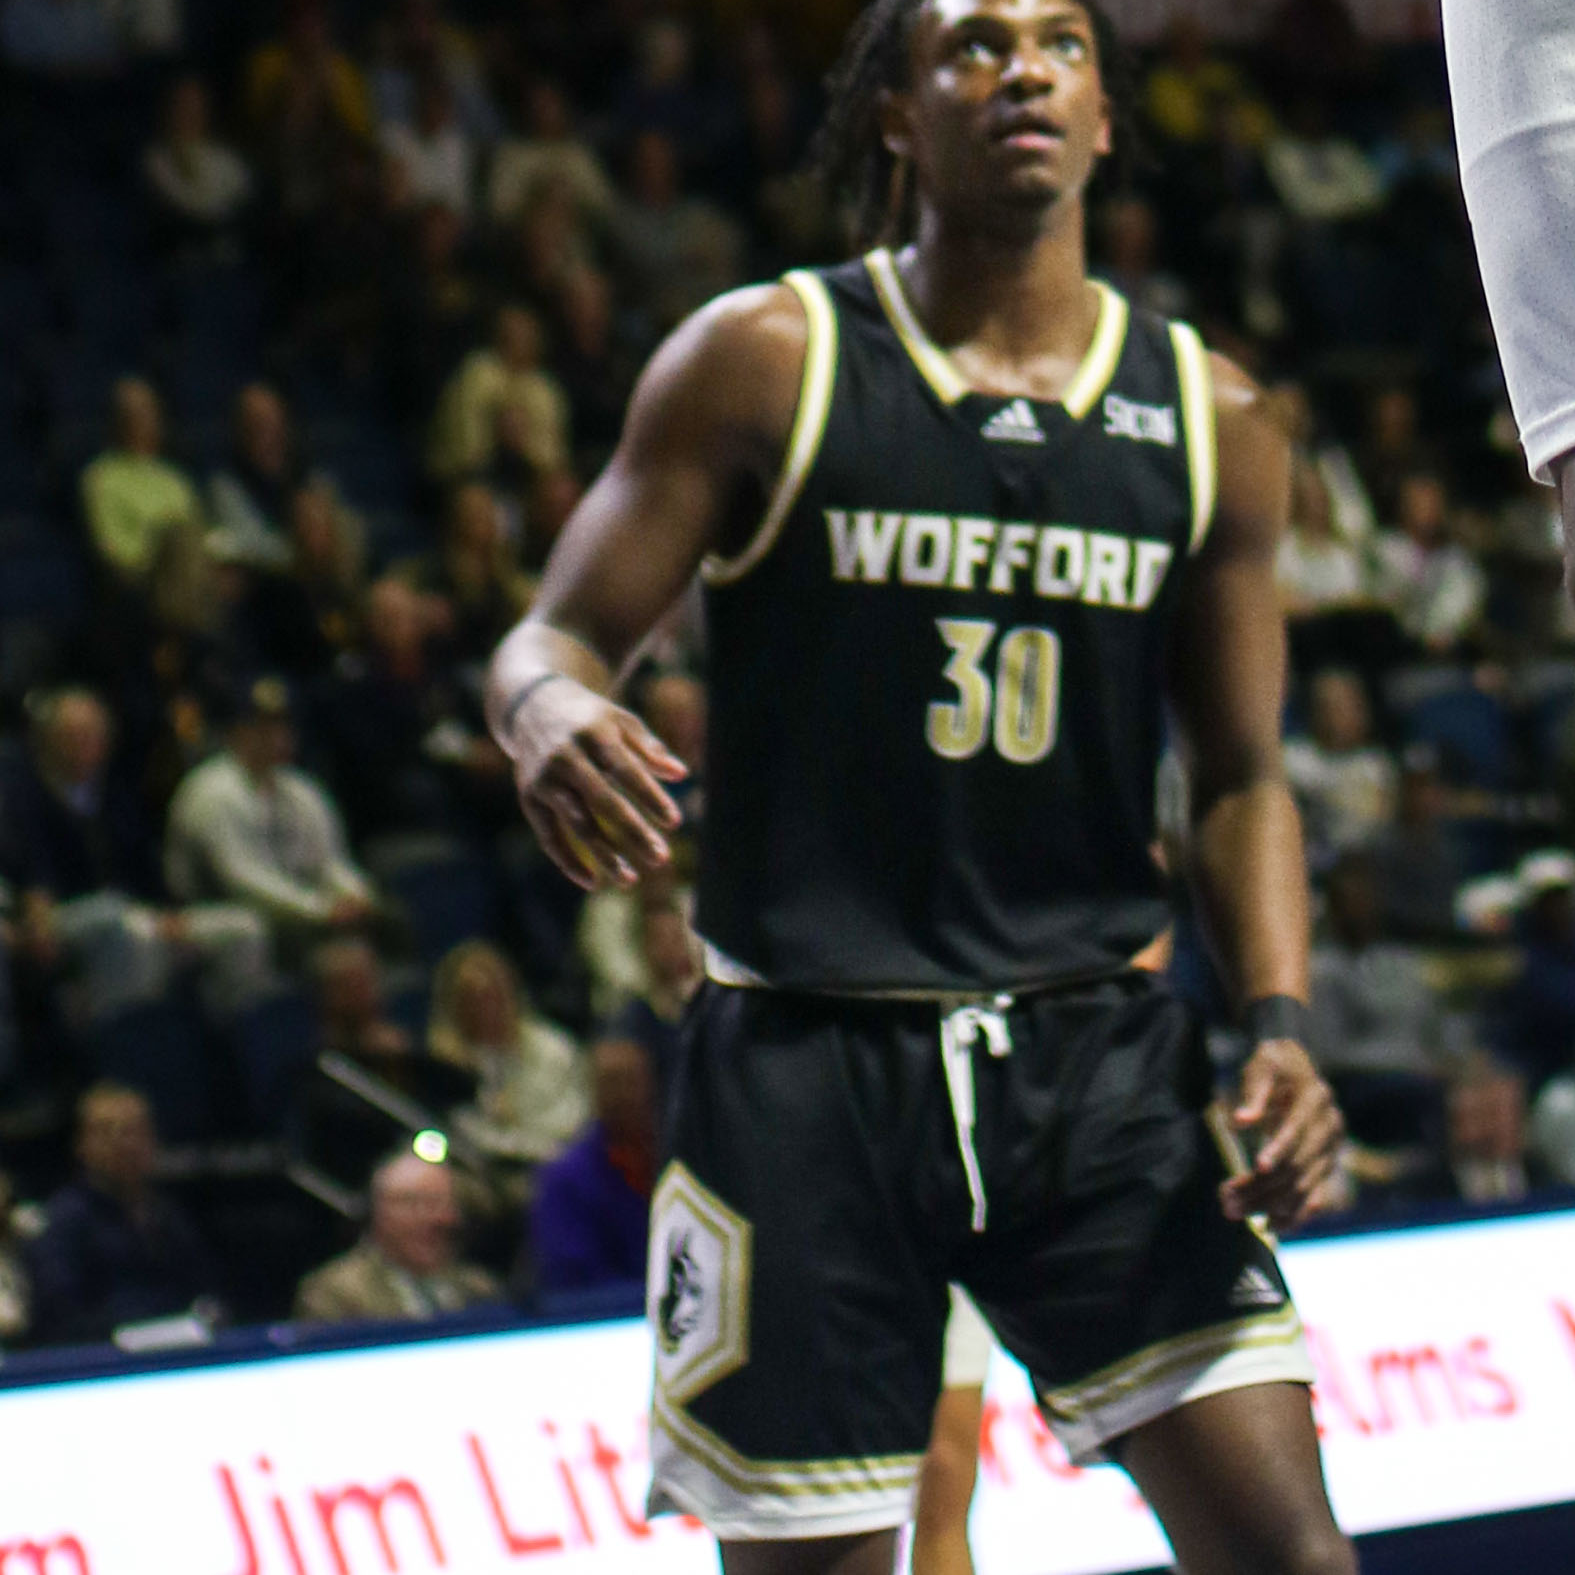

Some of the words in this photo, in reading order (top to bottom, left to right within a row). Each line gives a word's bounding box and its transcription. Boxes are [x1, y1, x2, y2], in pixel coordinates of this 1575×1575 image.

[823, 508, 1176, 613] WOFFORD
[925, 617, 1062, 765] 30
[214, 1450, 448, 1575] Jim
